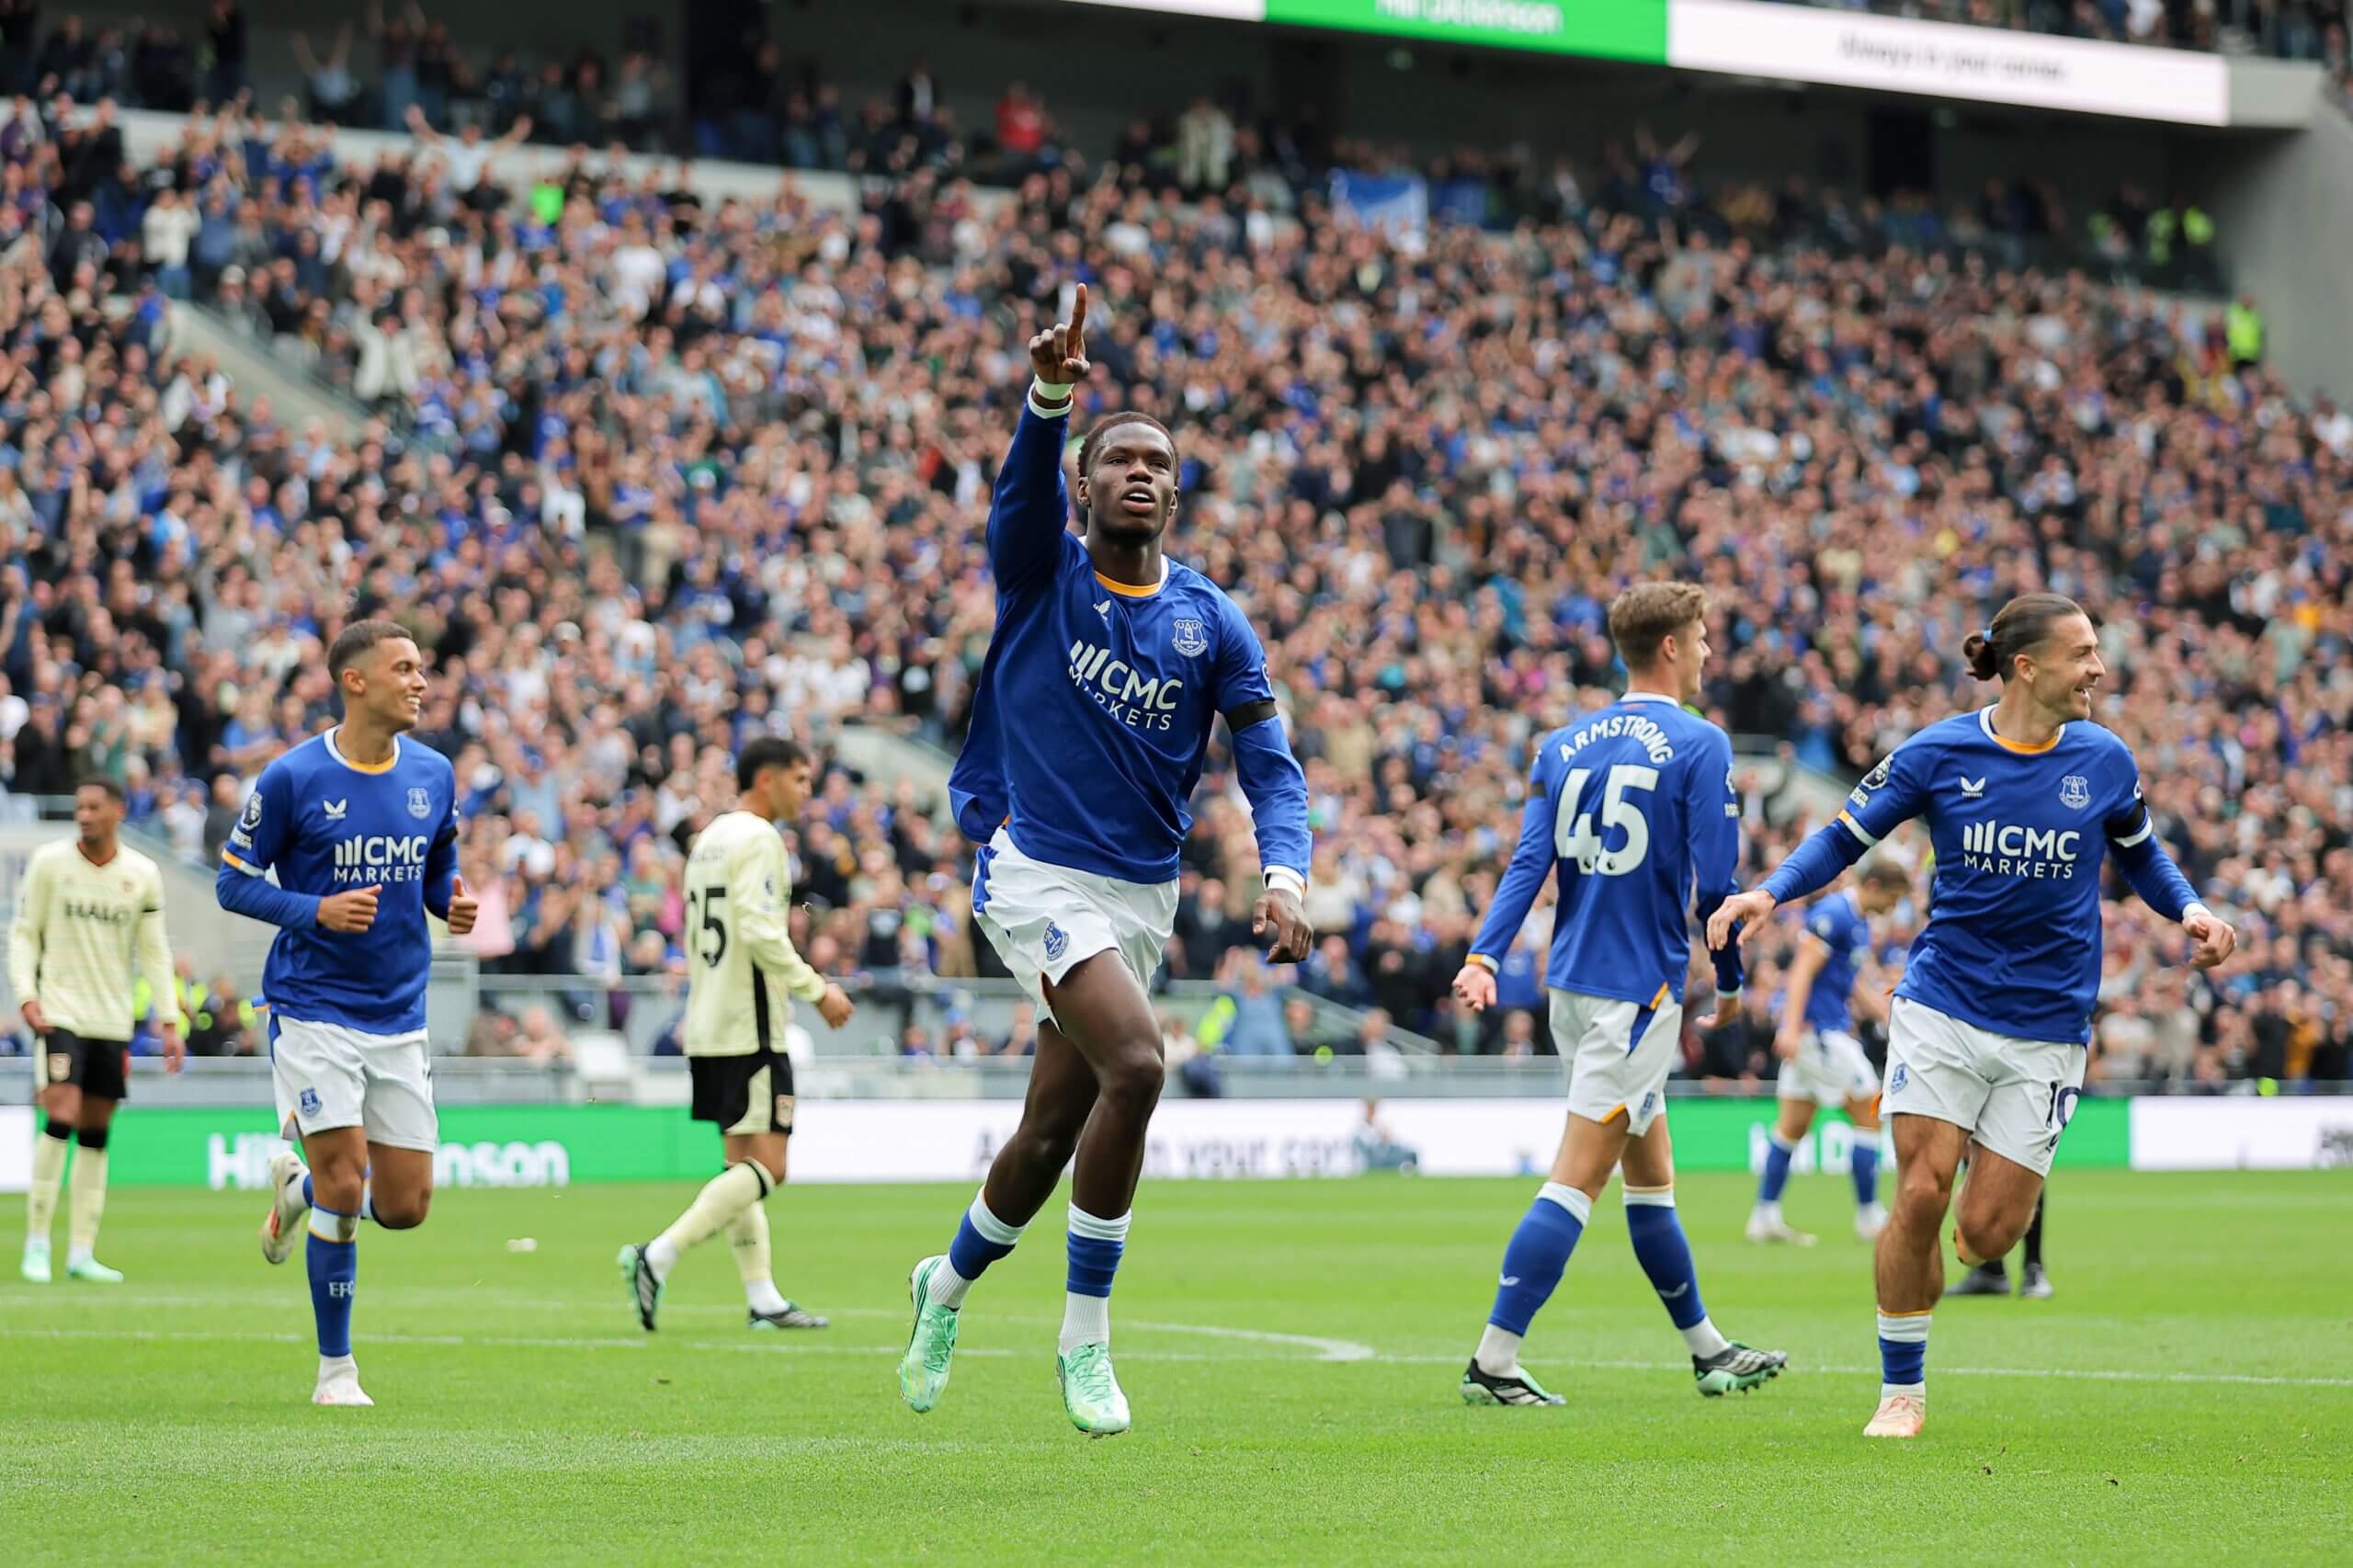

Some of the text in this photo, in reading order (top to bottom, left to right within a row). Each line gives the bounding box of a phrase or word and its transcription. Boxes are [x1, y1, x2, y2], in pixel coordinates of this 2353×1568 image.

[1069, 665, 1172, 731] MRKETS
[1101, 660, 1183, 710] CMC
[1559, 714, 1674, 765] ARMSTRONG
[1553, 765, 1660, 876] 45
[1997, 824, 2080, 861] CMC
[334, 864, 423, 883] MARKETS
[364, 835, 427, 865] CMC
[1963, 853, 2074, 880] MARKETS
[2045, 1081, 2082, 1130] 10
